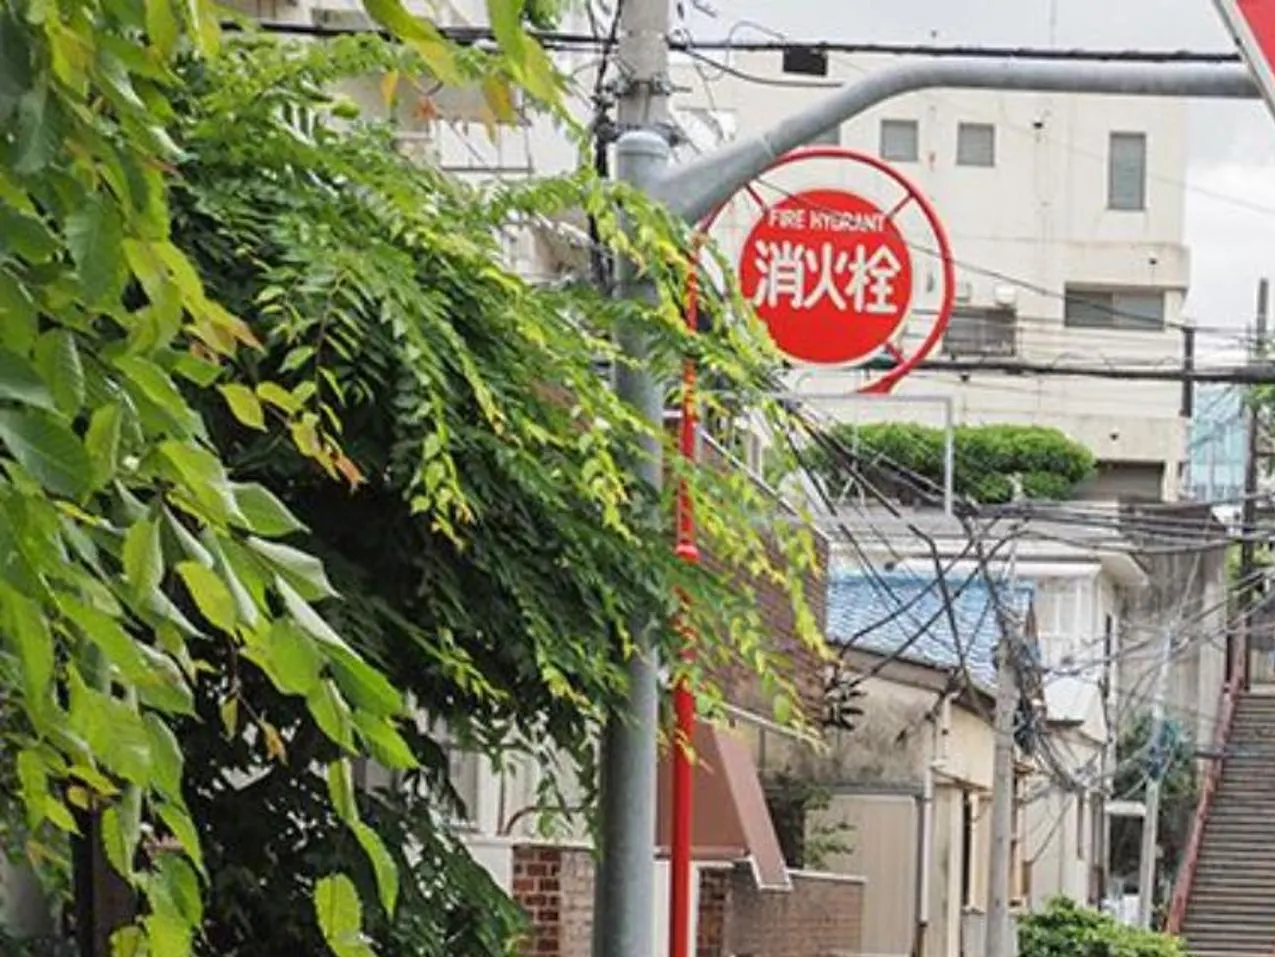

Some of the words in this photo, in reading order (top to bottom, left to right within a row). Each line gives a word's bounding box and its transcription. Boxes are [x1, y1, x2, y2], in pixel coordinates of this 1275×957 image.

[767, 208, 805, 230] FIRE
[753, 239, 901, 315] 消火栓
